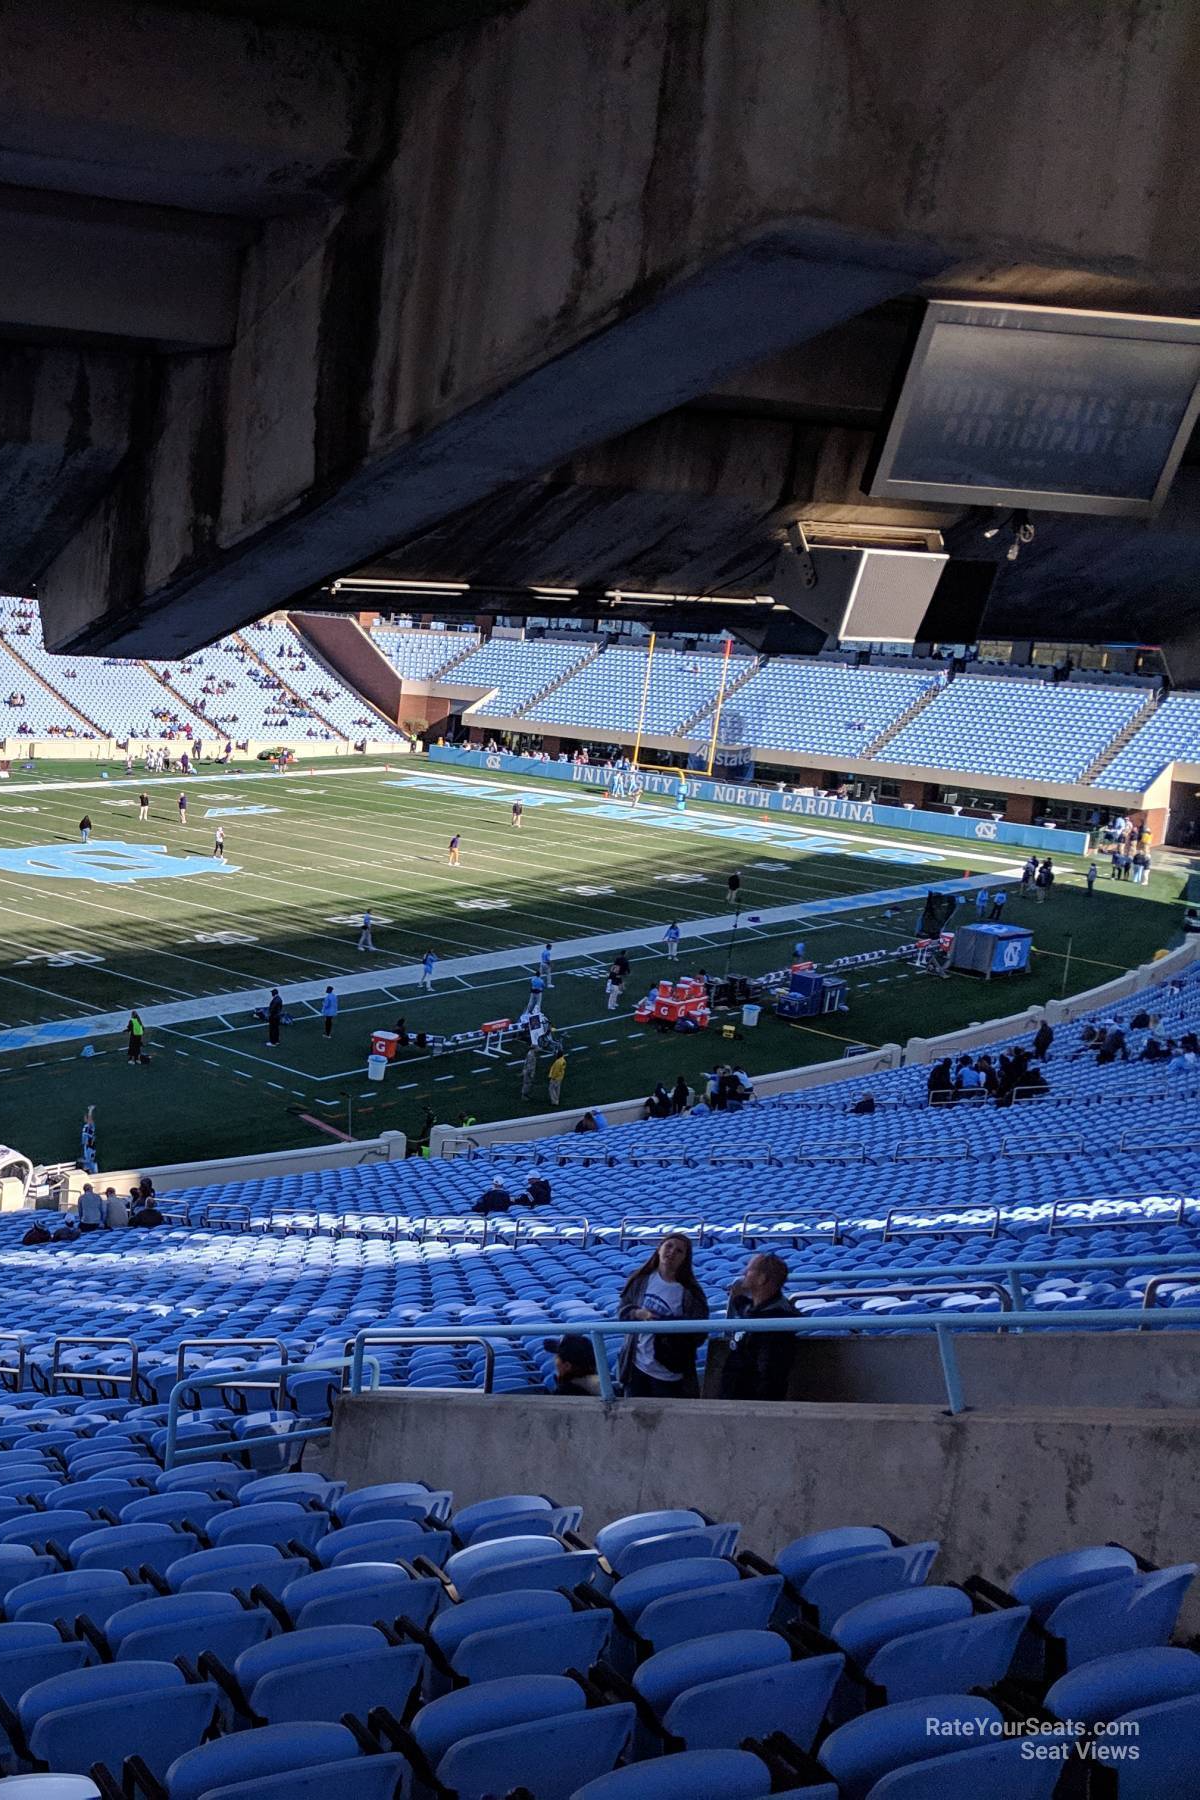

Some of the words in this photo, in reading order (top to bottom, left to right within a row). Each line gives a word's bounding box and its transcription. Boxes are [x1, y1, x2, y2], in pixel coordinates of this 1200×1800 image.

[696, 743, 751, 766] Astate
[572, 766, 673, 794] UNIVRSITY
[714, 787, 771, 809] NORTH
[782, 794, 875, 822] CAROLINA
[378, 776, 574, 806] TAR
[557, 804, 946, 864] HEELS
[26, 950, 106, 967] 30
[375, 1040, 386, 1052] G
